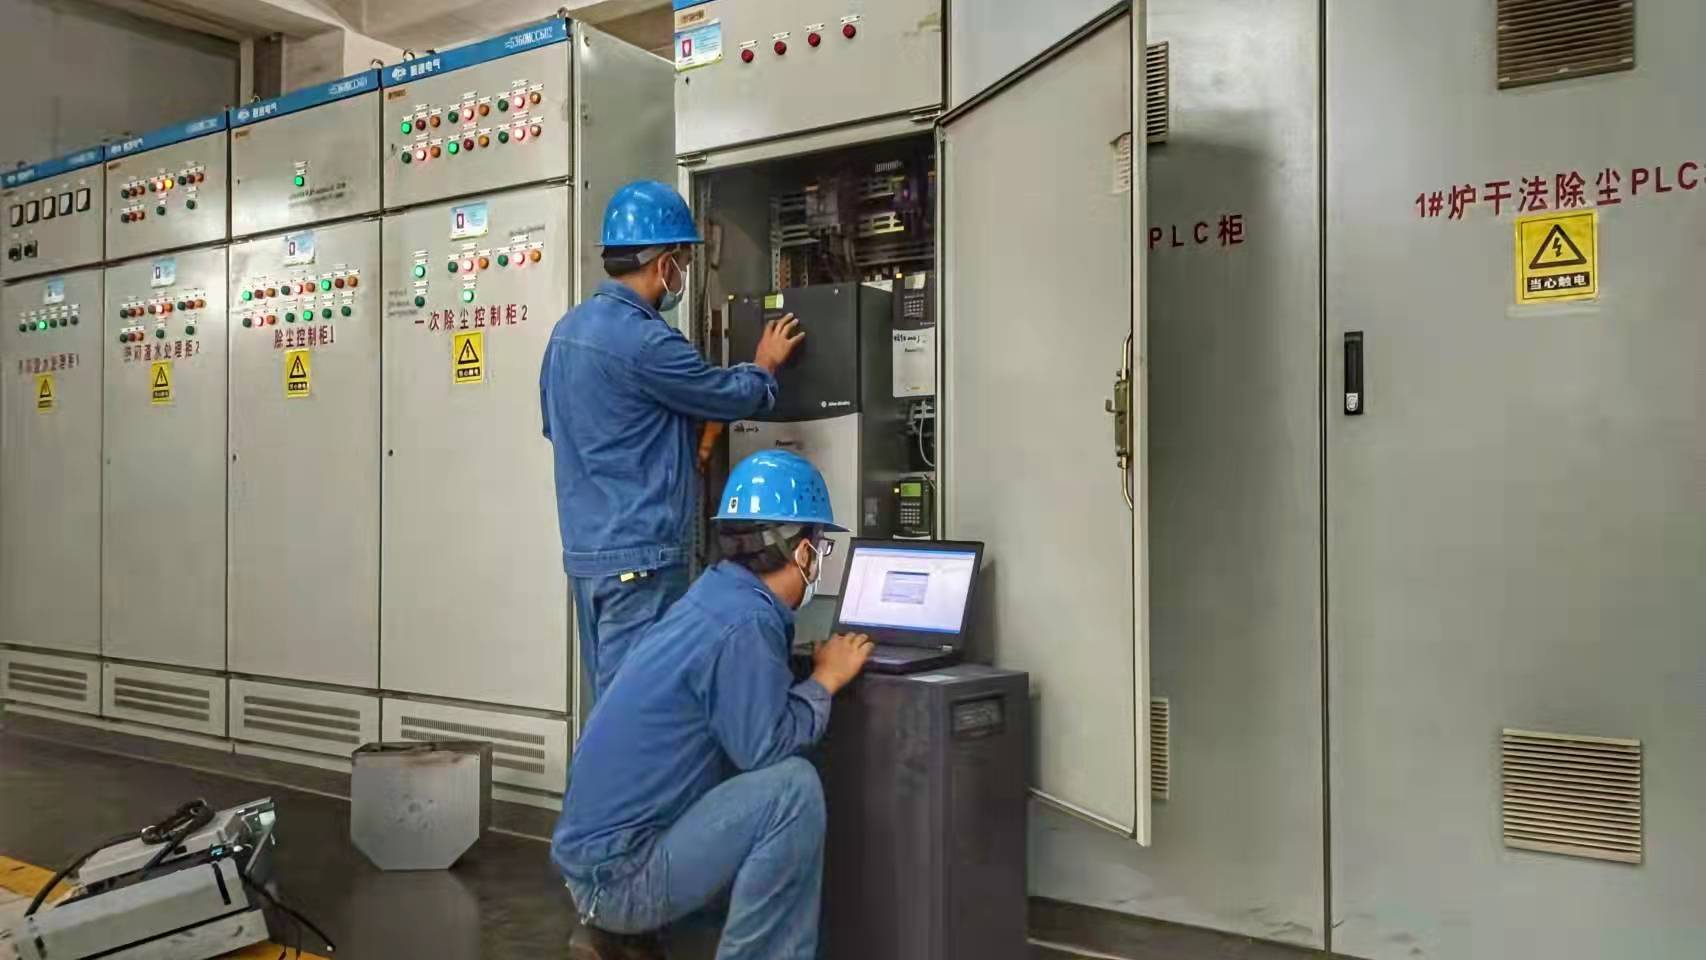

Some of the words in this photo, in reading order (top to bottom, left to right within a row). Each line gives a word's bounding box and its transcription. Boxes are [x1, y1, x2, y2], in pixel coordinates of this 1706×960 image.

[1415, 161, 1706, 221] 1#炉干法除尘PLC
[1529, 274, 1588, 292] 当心触电
[414, 303, 529, 332] 一次除尘控制柜2
[273, 324, 335, 350] 除尘控制柜1
